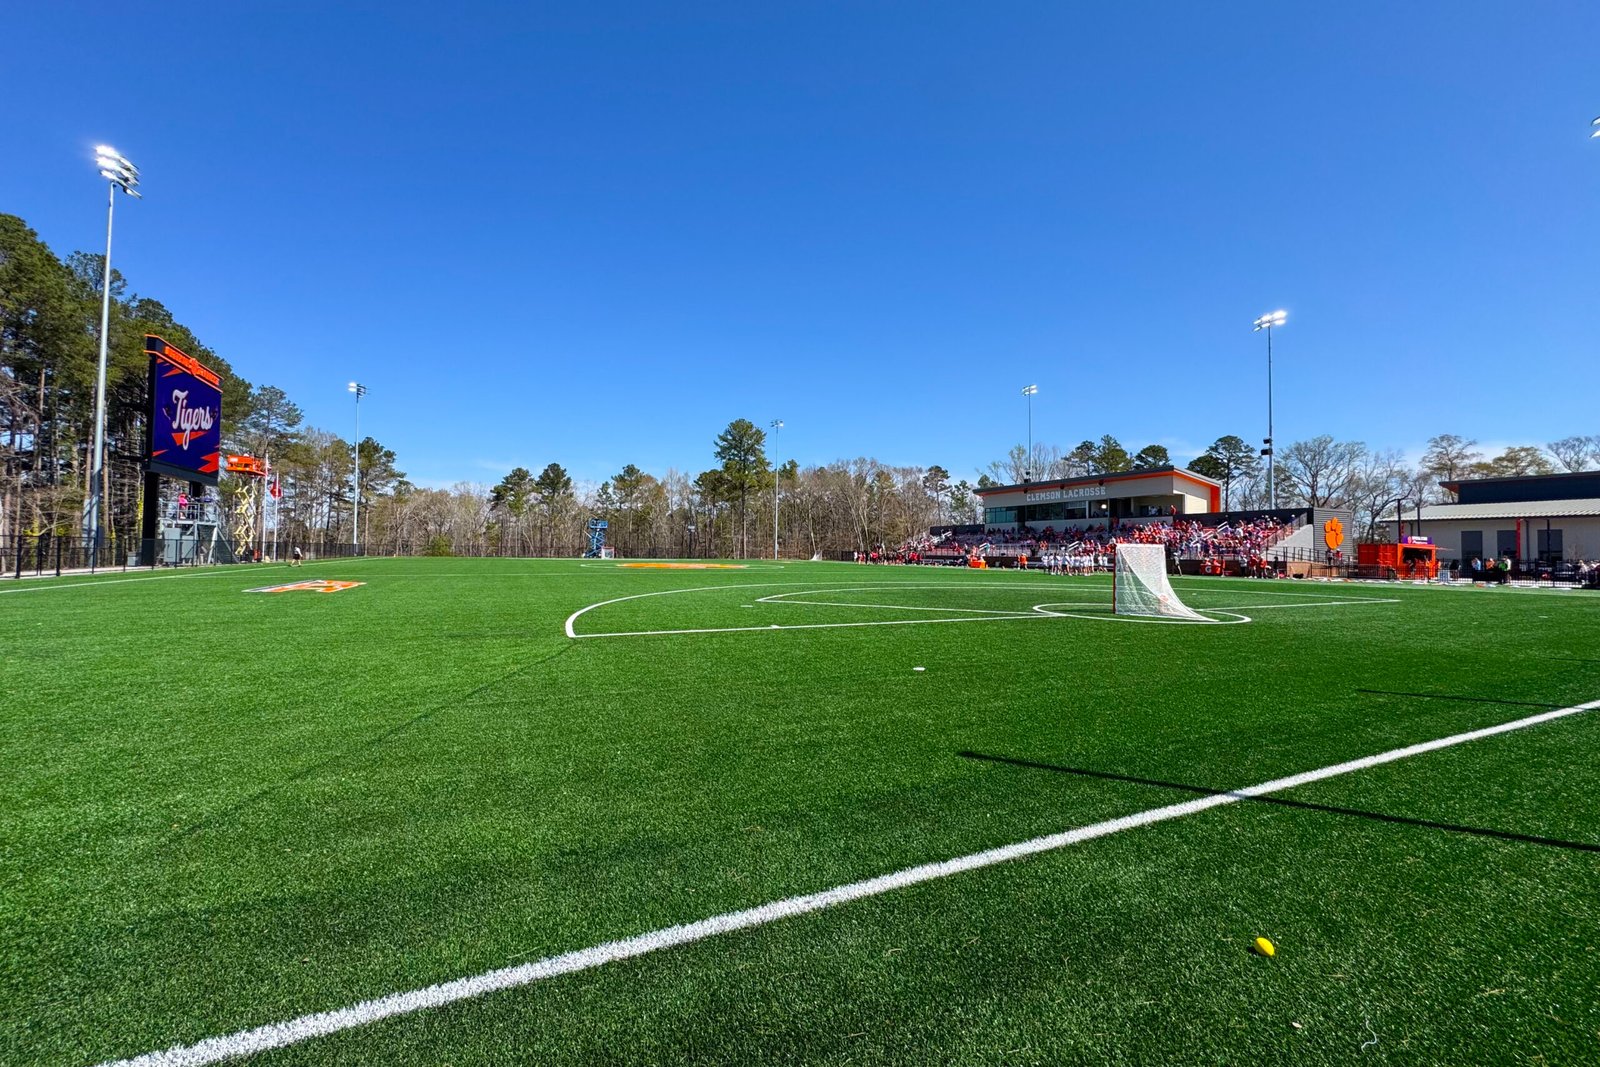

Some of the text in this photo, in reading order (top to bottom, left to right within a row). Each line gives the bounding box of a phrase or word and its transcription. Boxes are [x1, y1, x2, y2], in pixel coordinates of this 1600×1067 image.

[172, 389, 213, 450] Tigers
[1026, 486, 1106, 502] CLEMSON LACROSSE
